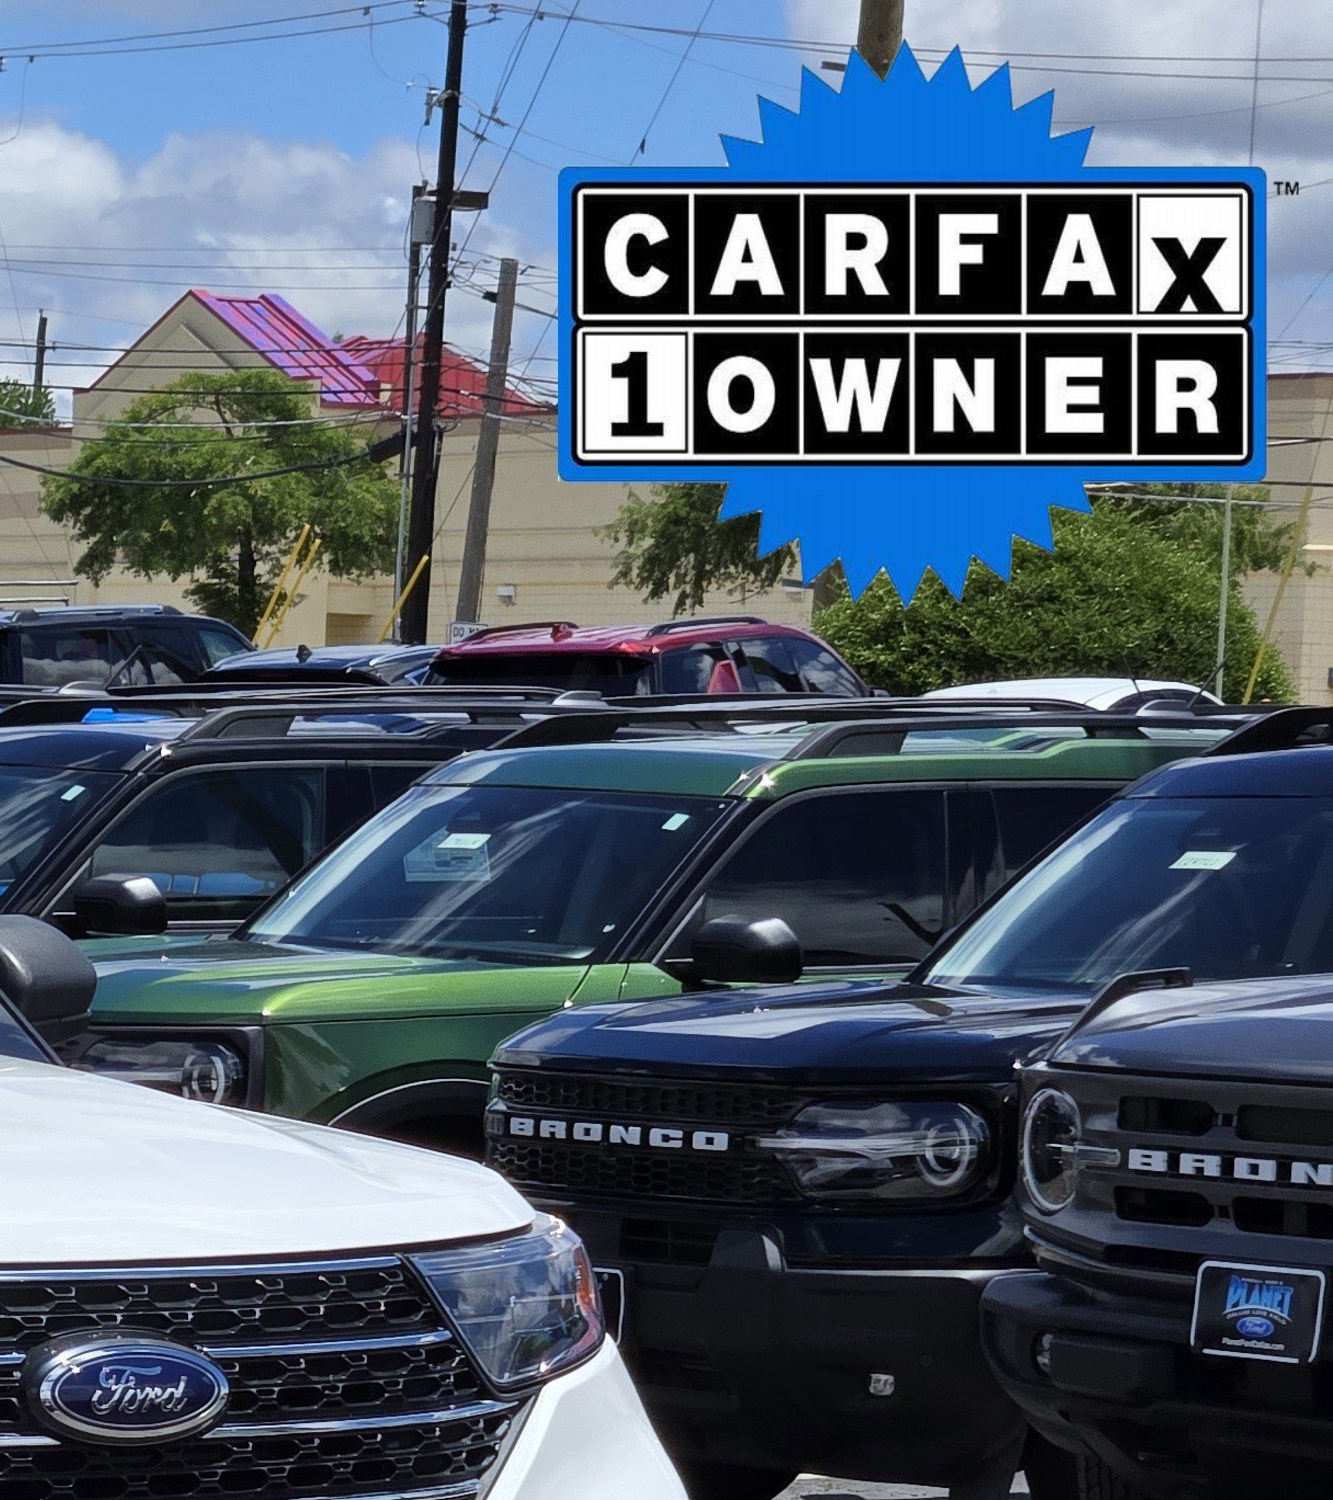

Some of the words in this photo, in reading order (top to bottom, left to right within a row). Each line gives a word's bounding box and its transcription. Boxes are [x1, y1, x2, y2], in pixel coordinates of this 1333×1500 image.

[509, 1116, 729, 1151] BRONCO
[1226, 1274, 1294, 1317] PLANET
[91, 1364, 188, 1416] Ford
